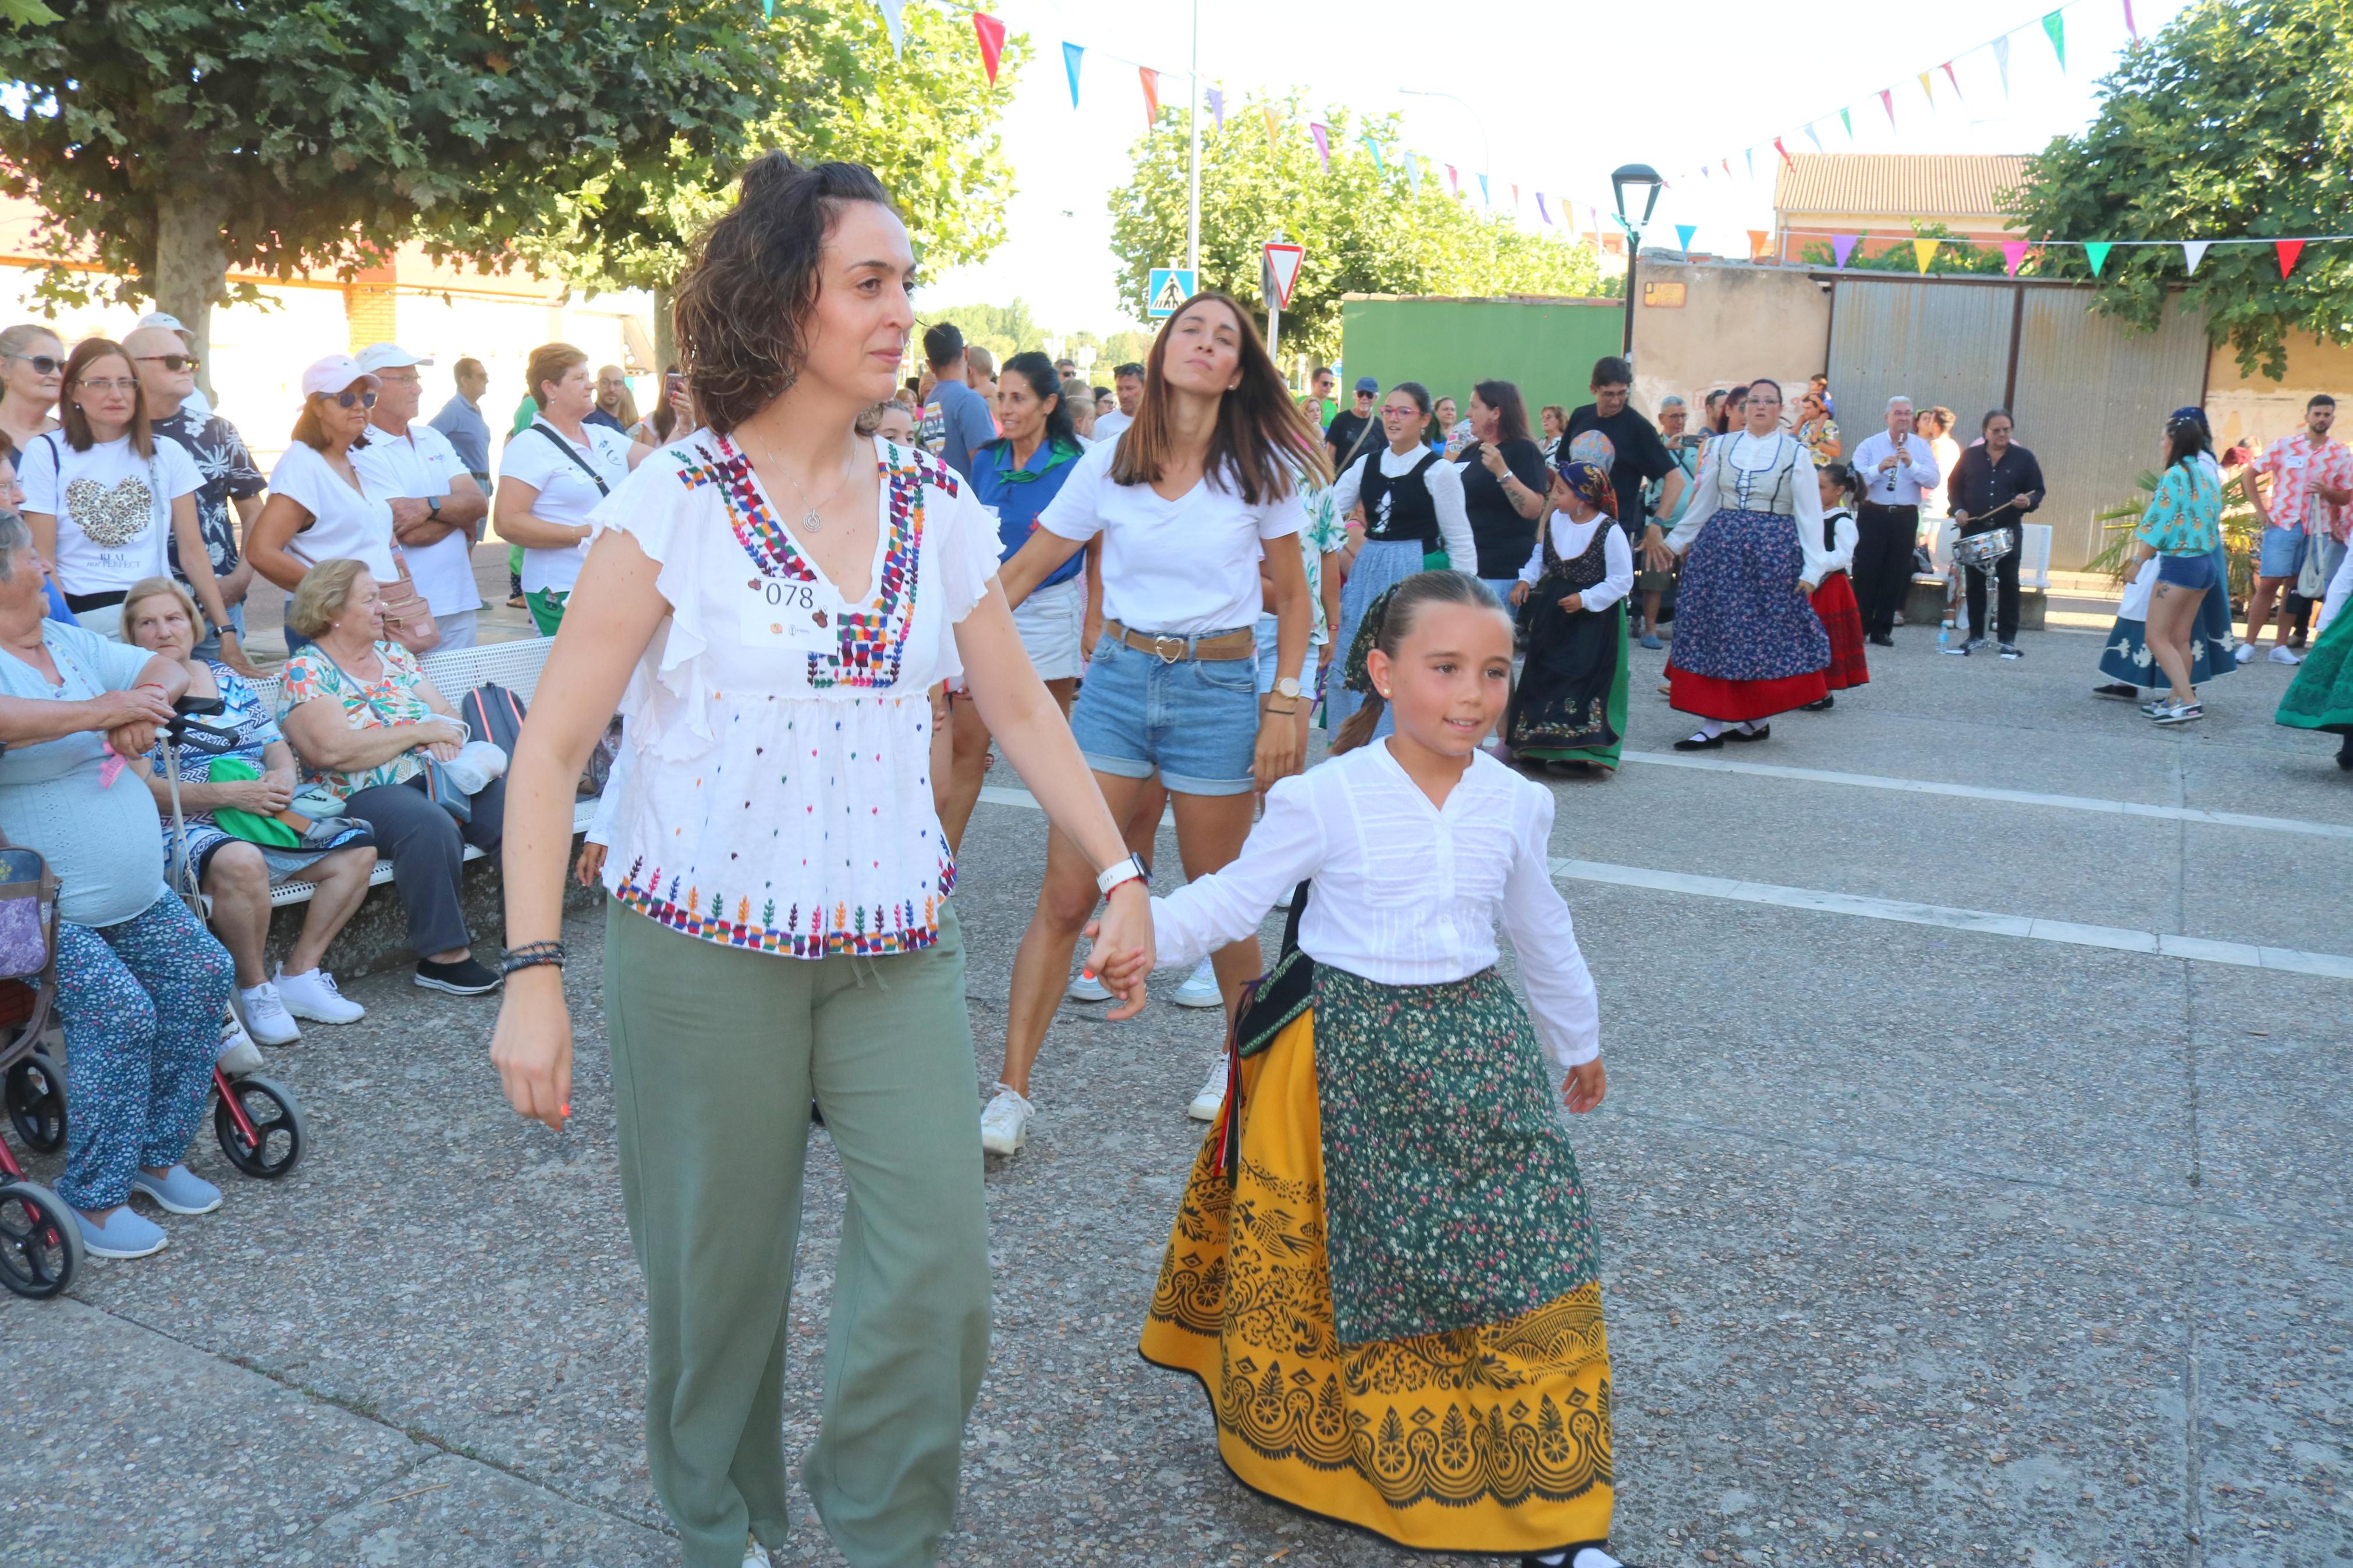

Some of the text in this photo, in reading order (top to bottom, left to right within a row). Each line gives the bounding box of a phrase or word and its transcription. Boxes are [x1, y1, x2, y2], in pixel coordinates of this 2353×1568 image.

[100, 553, 125, 561] REAL
[102, 560, 141, 568] PERFECT
[766, 582, 813, 609] 078
